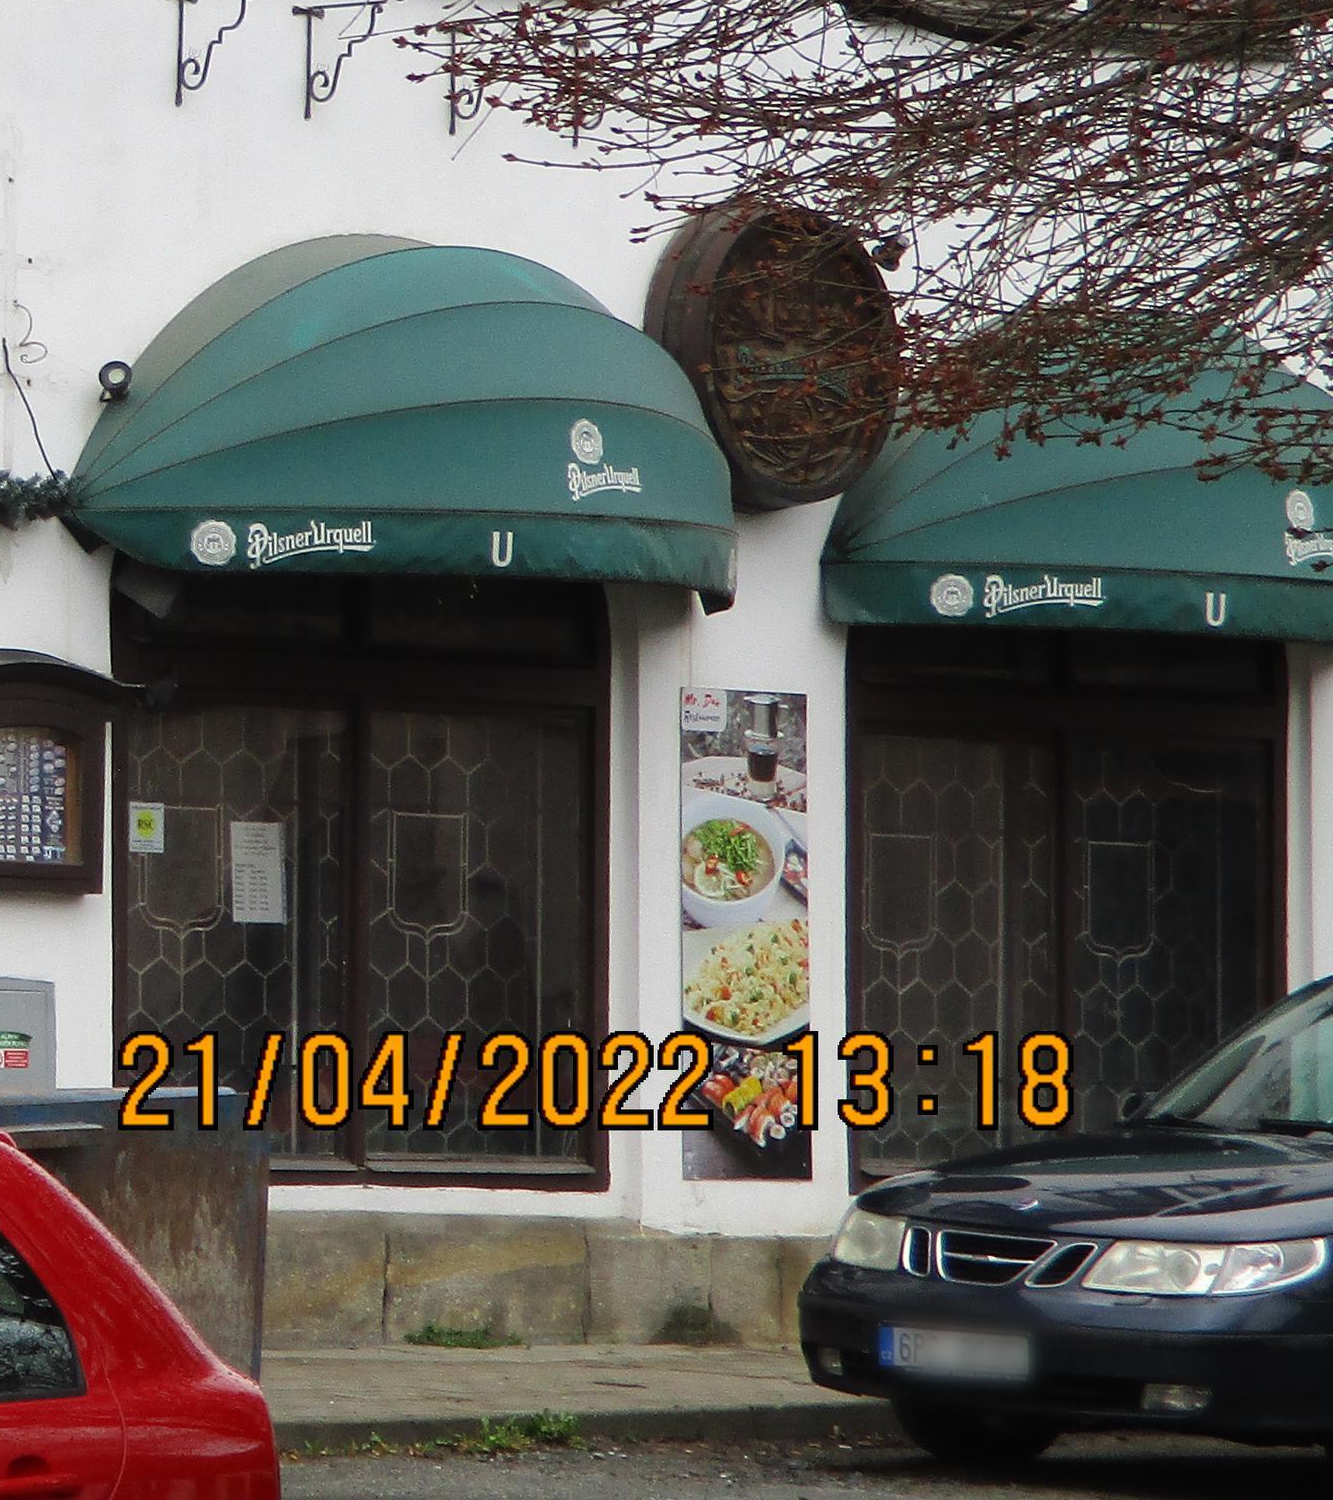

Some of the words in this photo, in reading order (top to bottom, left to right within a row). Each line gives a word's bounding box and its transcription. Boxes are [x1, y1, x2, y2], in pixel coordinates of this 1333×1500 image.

[567, 462, 606, 501] Pilsner
[602, 462, 641, 493] Urquell
[247, 522, 313, 570] Pilsner
[309, 519, 373, 555] Urquell
[490, 531, 514, 568] U
[983, 574, 1046, 618] Pilsner
[1043, 574, 1102, 607] Urquell
[1205, 592, 1227, 627] U
